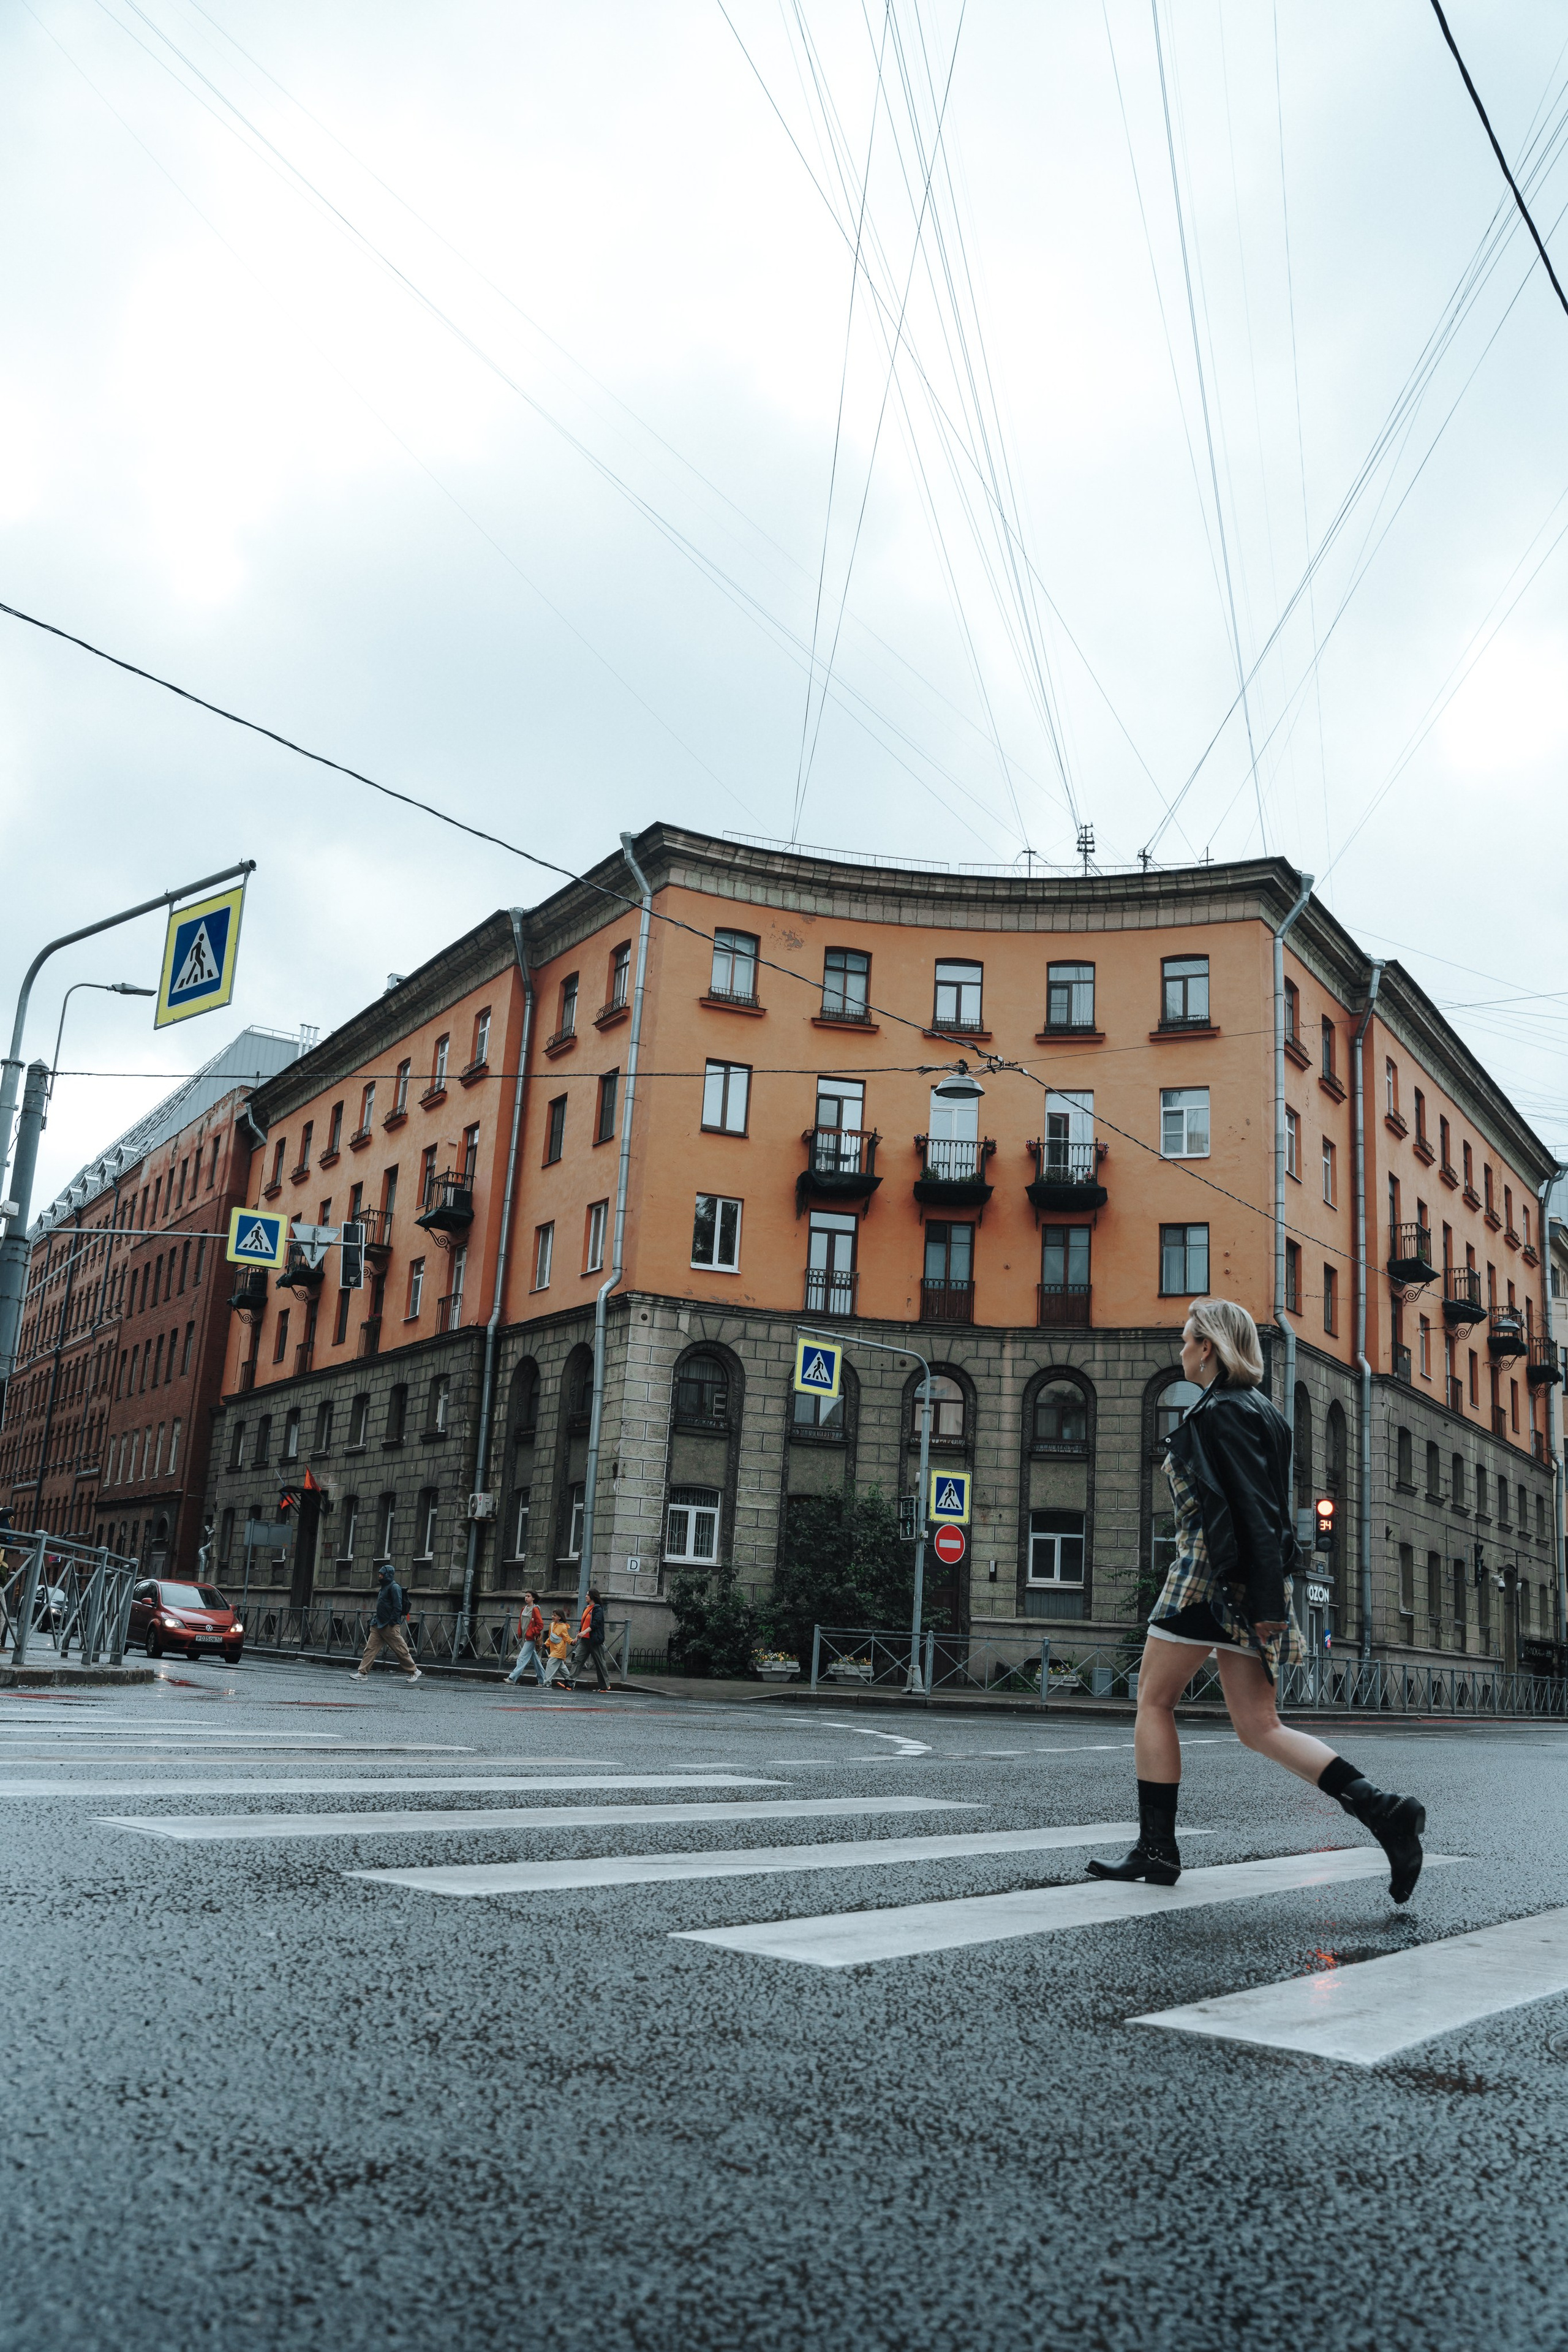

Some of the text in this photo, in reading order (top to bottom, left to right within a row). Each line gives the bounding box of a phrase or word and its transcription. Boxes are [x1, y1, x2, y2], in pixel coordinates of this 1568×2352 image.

[1320, 1520, 1332, 1530] 34
[630, 1559, 638, 1570] D
[1309, 1585, 1329, 1603] OZON
